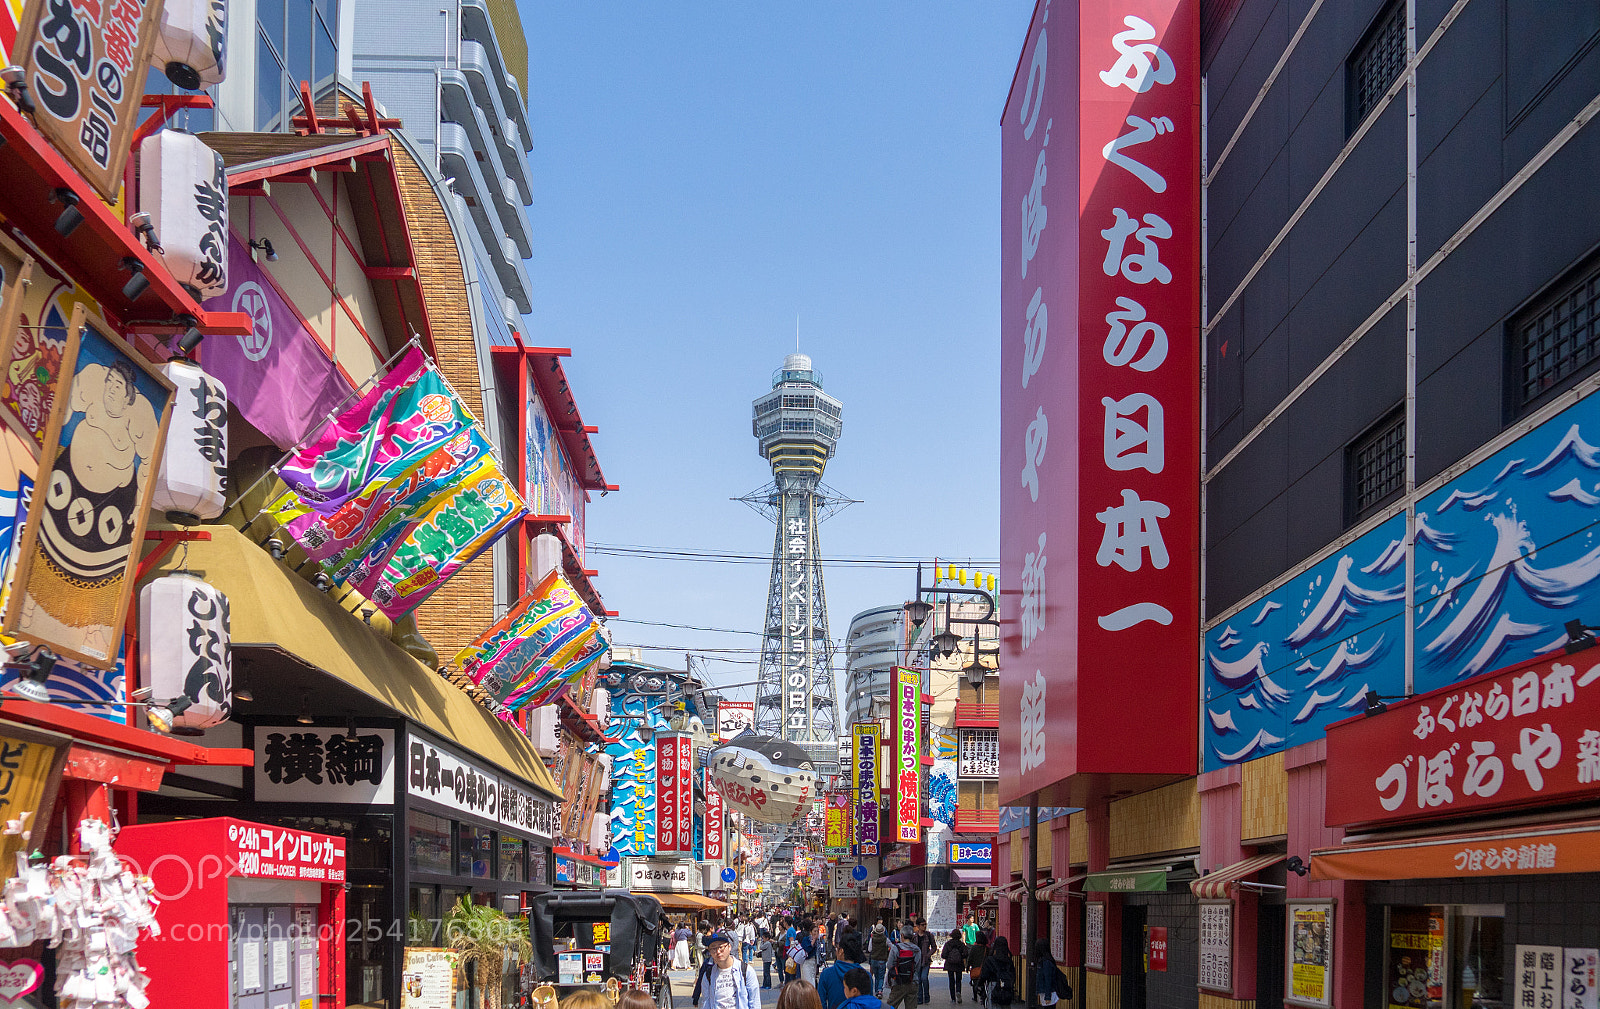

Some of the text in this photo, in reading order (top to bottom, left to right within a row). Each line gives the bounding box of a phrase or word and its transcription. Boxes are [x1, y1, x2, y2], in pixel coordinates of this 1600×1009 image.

[1097, 15, 1176, 631] ふぐなら日本一
[1020, 0, 1052, 776] づぼらや新館
[788, 518, 807, 729] 社会イノベーションの日立
[902, 686, 916, 768] 日本一の串かつ
[264, 732, 384, 786] 横綱
[410, 742, 497, 816] 日本一の串かつ
[859, 735, 875, 800] 日本一の串かつ
[661, 744, 674, 846] 名物 てっちり
[680, 744, 691, 846] 名物 てっちり
[855, 801, 878, 843] 横綱
[899, 769, 919, 825] 横綱
[239, 826, 345, 866] 24h コインロッカー
[901, 827, 917, 839] 酒処
[1454, 843, 1557, 870] づぼらや新館
[239, 852, 259, 875] ¥200
[261, 863, 297, 877] COIN-LOCKER
